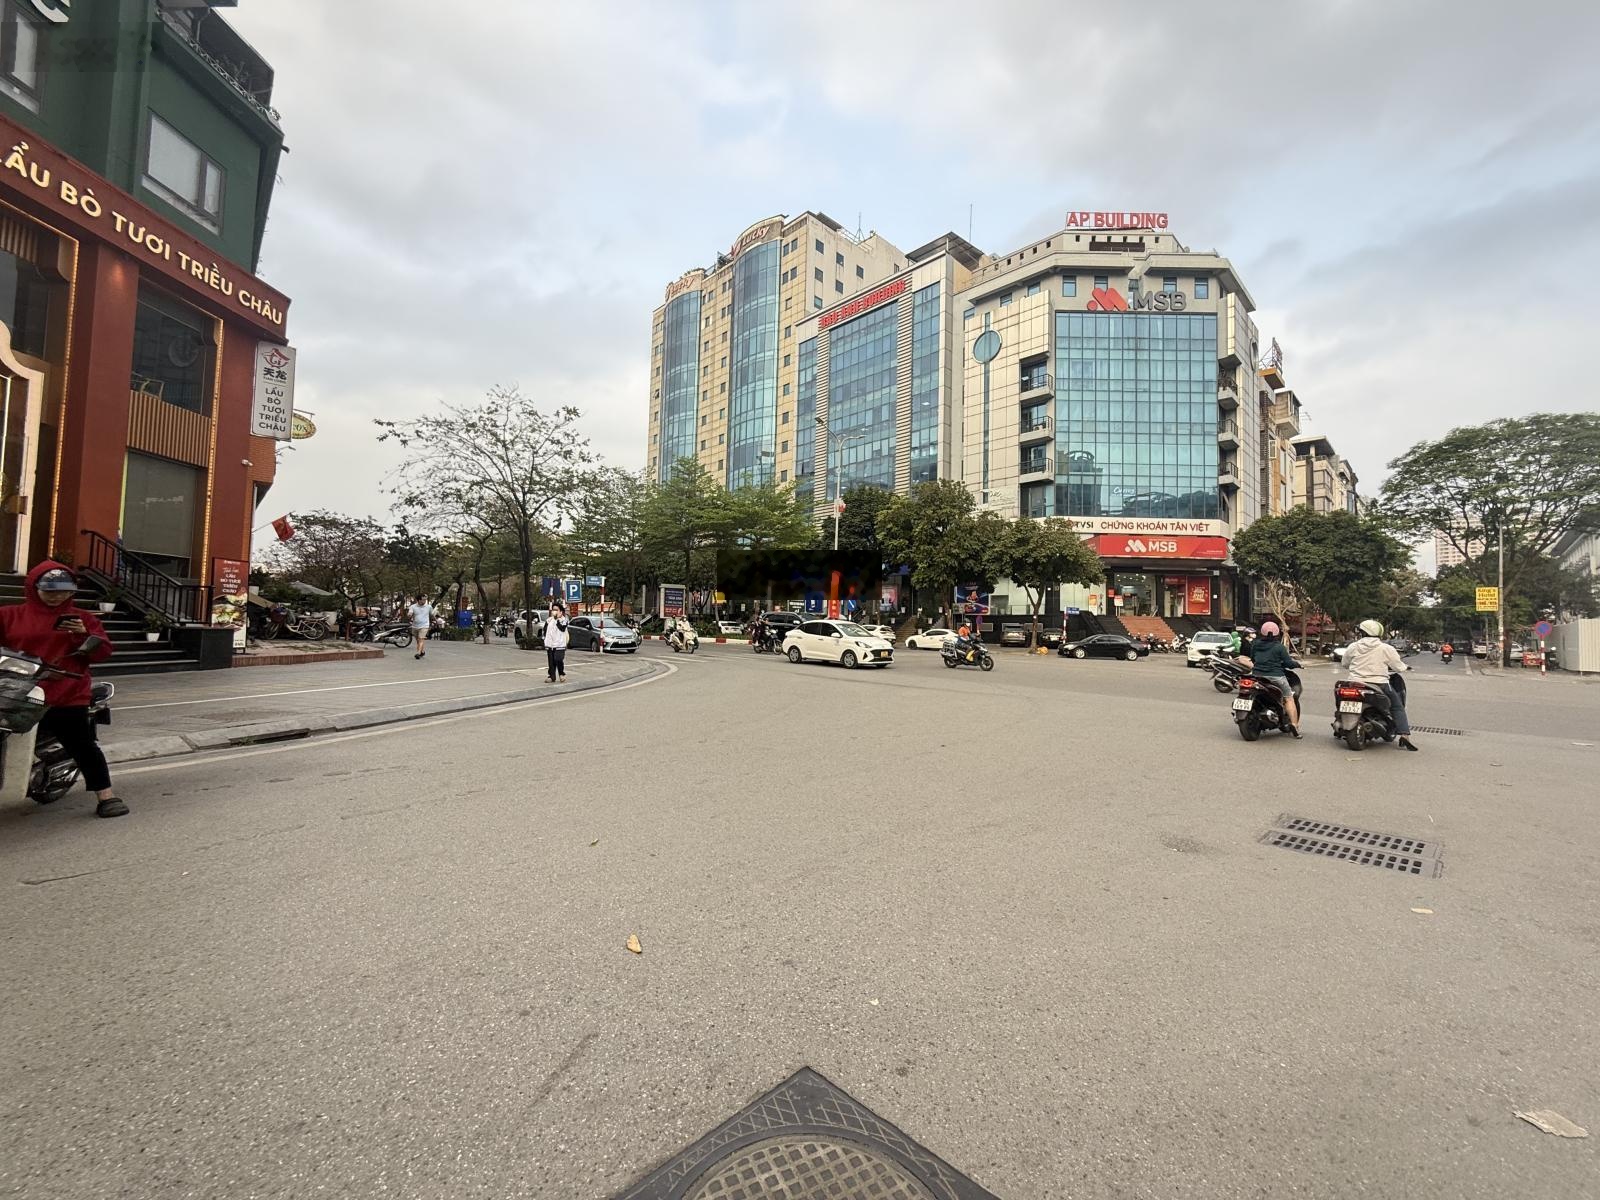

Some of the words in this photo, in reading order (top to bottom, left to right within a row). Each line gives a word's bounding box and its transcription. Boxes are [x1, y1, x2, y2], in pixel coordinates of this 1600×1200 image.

[1066, 211, 1090, 227] AP
[1094, 212, 1169, 229] BUILDING
[0, 141, 50, 188] ẨU
[60, 180, 102, 218] BÒ
[112, 211, 171, 261] TƯƠI
[177, 251, 233, 296] TRIỀU
[238, 289, 283, 325] CHÂU
[1132, 290, 1187, 311] MSB
[1075, 520, 1094, 529] TVSI
[1100, 520, 1134, 530] CHỨNG
[1136, 521, 1168, 530] KHOÁN
[1169, 521, 1188, 531] TÂN
[1189, 522, 1210, 532] VIỆT
[1148, 541, 1178, 553] MSB
[569, 584, 578, 596] P
